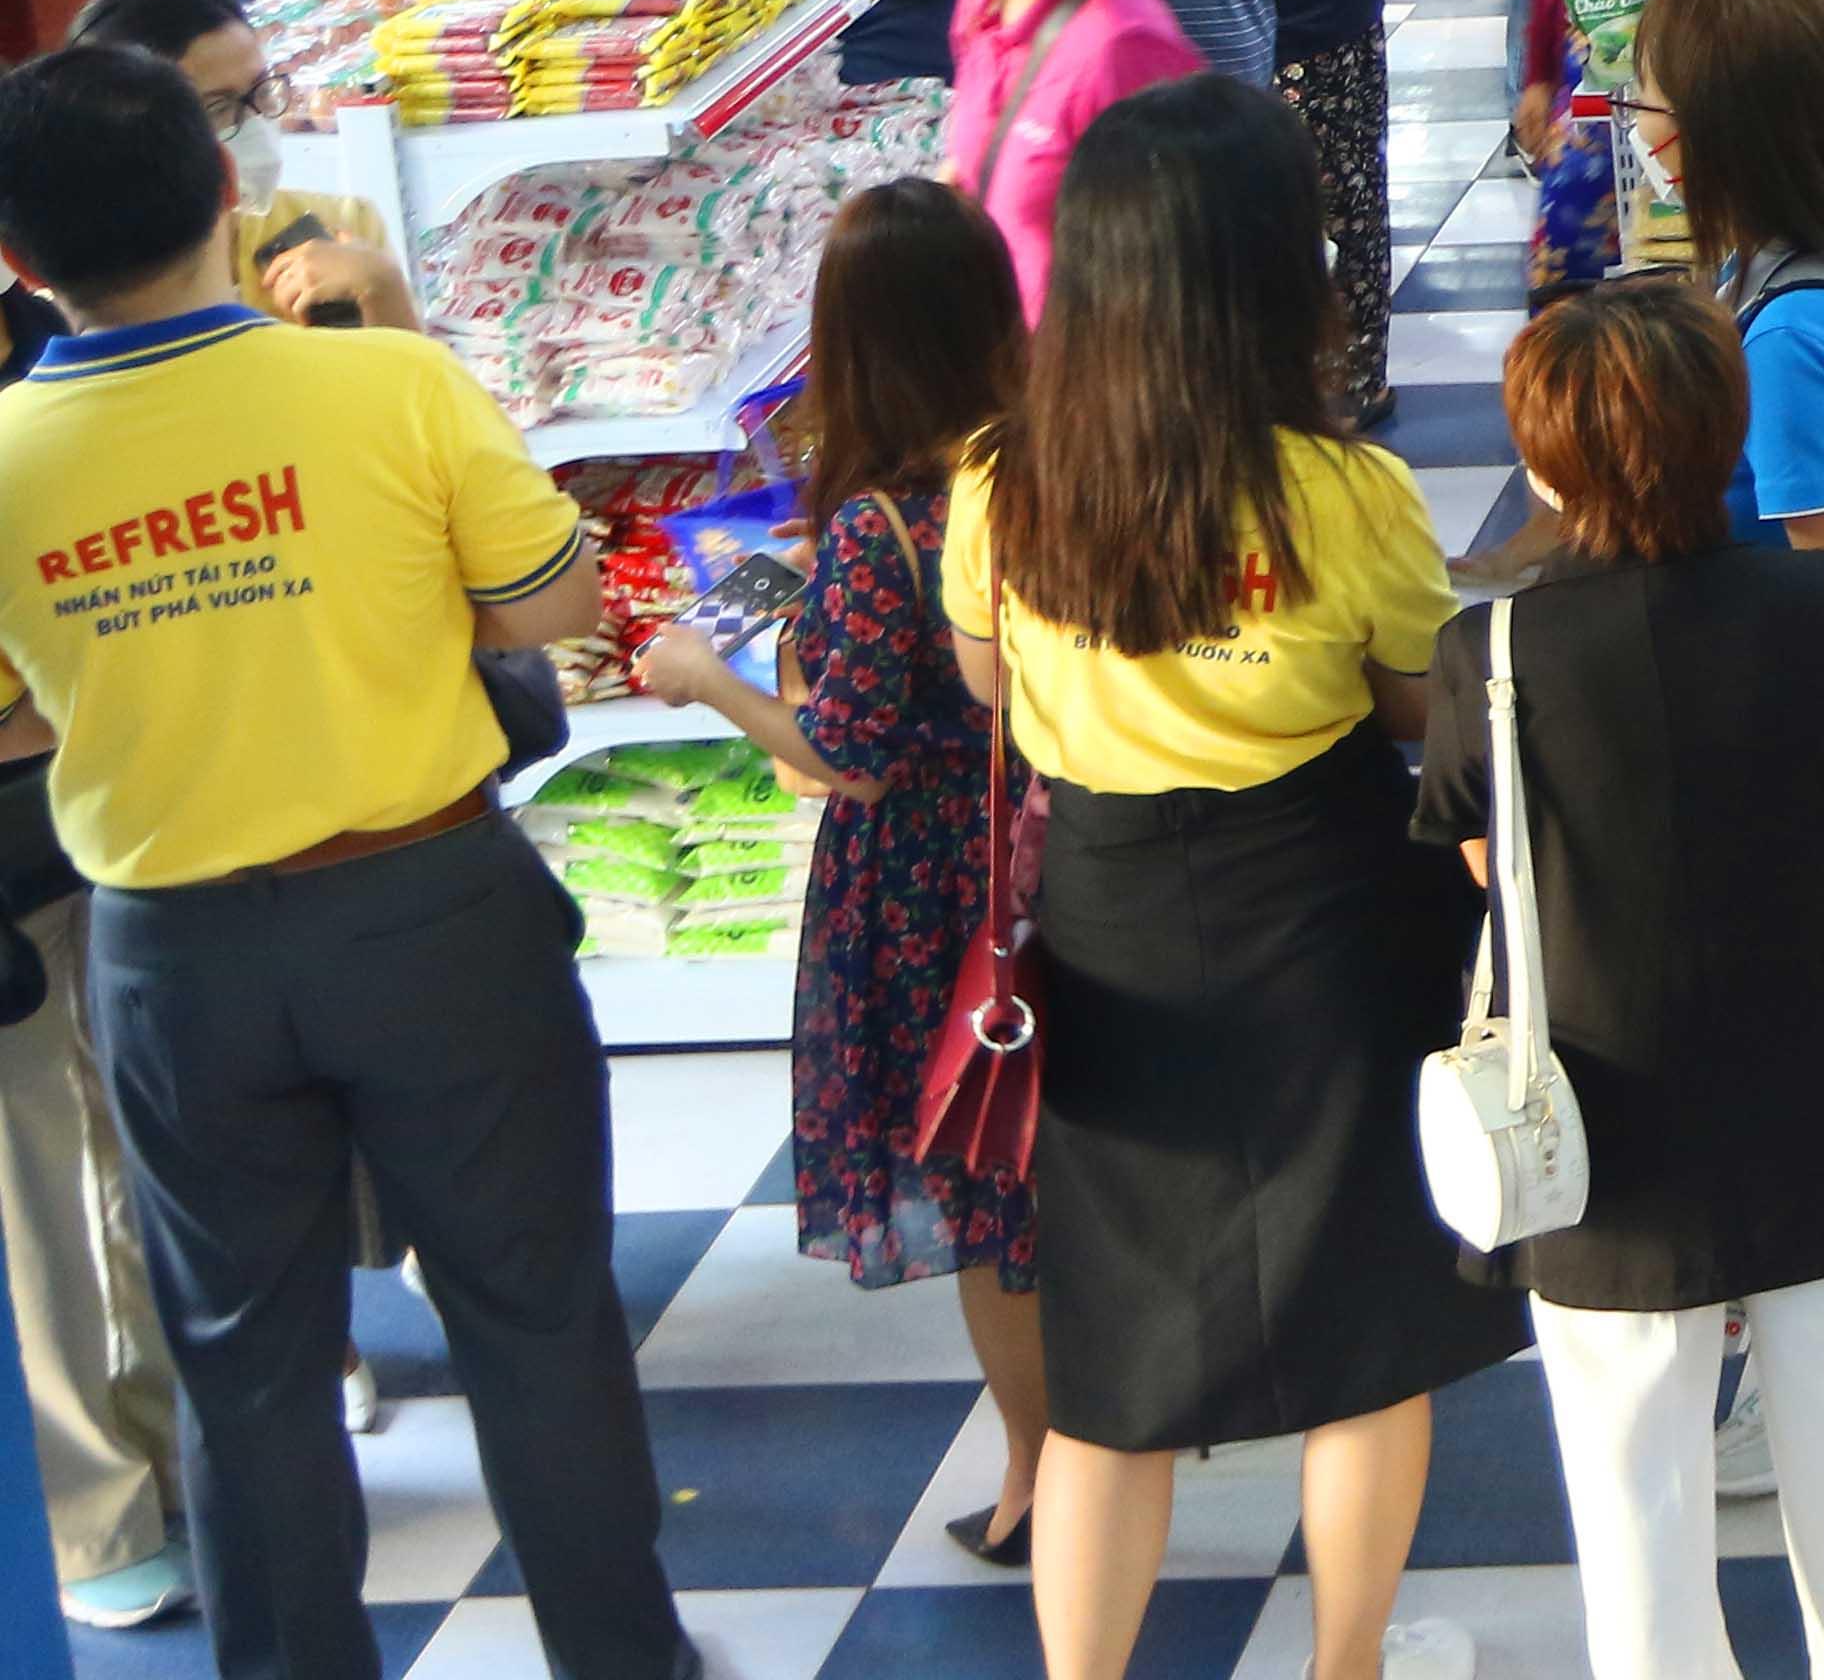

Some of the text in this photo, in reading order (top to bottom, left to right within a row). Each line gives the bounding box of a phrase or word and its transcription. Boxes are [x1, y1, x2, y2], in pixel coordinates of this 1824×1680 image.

[35, 464, 306, 585] REFRESH
[129, 572, 175, 599] NÚT
[184, 563, 221, 586] TÁI
[228, 554, 276, 582] TẠO
[149, 594, 202, 624] PHÁ
[282, 576, 313, 598] XA
[1240, 649, 1271, 666] XA
